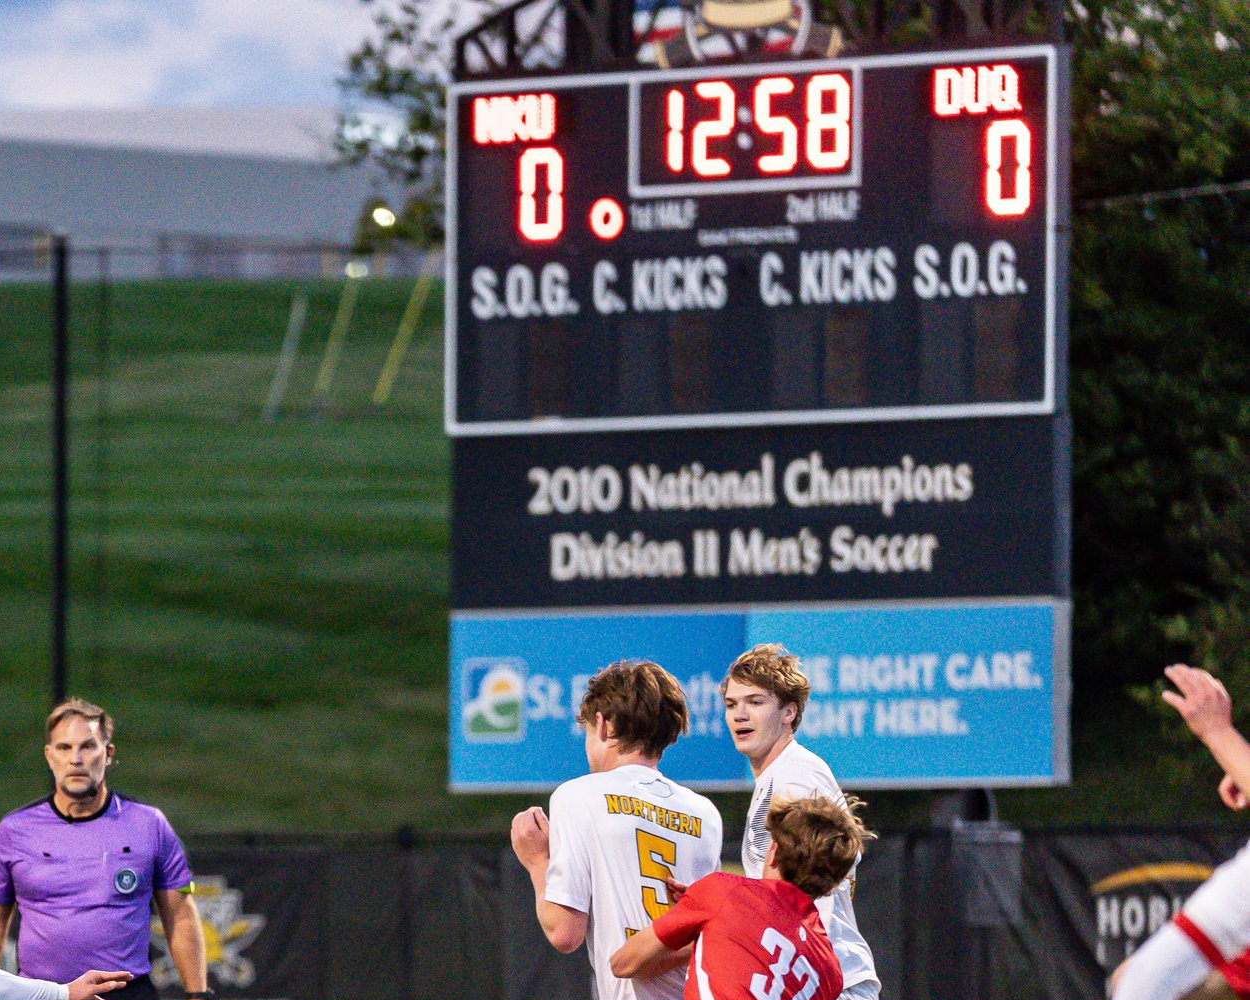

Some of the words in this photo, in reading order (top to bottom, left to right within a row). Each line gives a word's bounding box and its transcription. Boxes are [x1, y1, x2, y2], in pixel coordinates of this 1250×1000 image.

[666, 73, 851, 178] 12:58
[519, 147, 564, 240] 0
[985, 118, 1031, 216] 0
[470, 262, 580, 320] S.O.G.
[592, 260, 627, 315] C.
[631, 255, 729, 312] KICKS
[759, 251, 794, 307] C.
[799, 246, 897, 304] KICKS
[912, 239, 1028, 299] S.O.G.
[527, 464, 623, 516] 2010
[628, 453, 775, 513] National
[783, 451, 974, 517] Champions
[550, 530, 685, 581] Division
[728, 527, 823, 577] Men's
[829, 524, 939, 574] Soccer
[840, 653, 938, 692] RIGHT
[945, 650, 1042, 690] CARE.
[874, 699, 969, 737] HERE.
[605, 793, 702, 839] NORTHERN
[635, 829, 677, 923] 5
